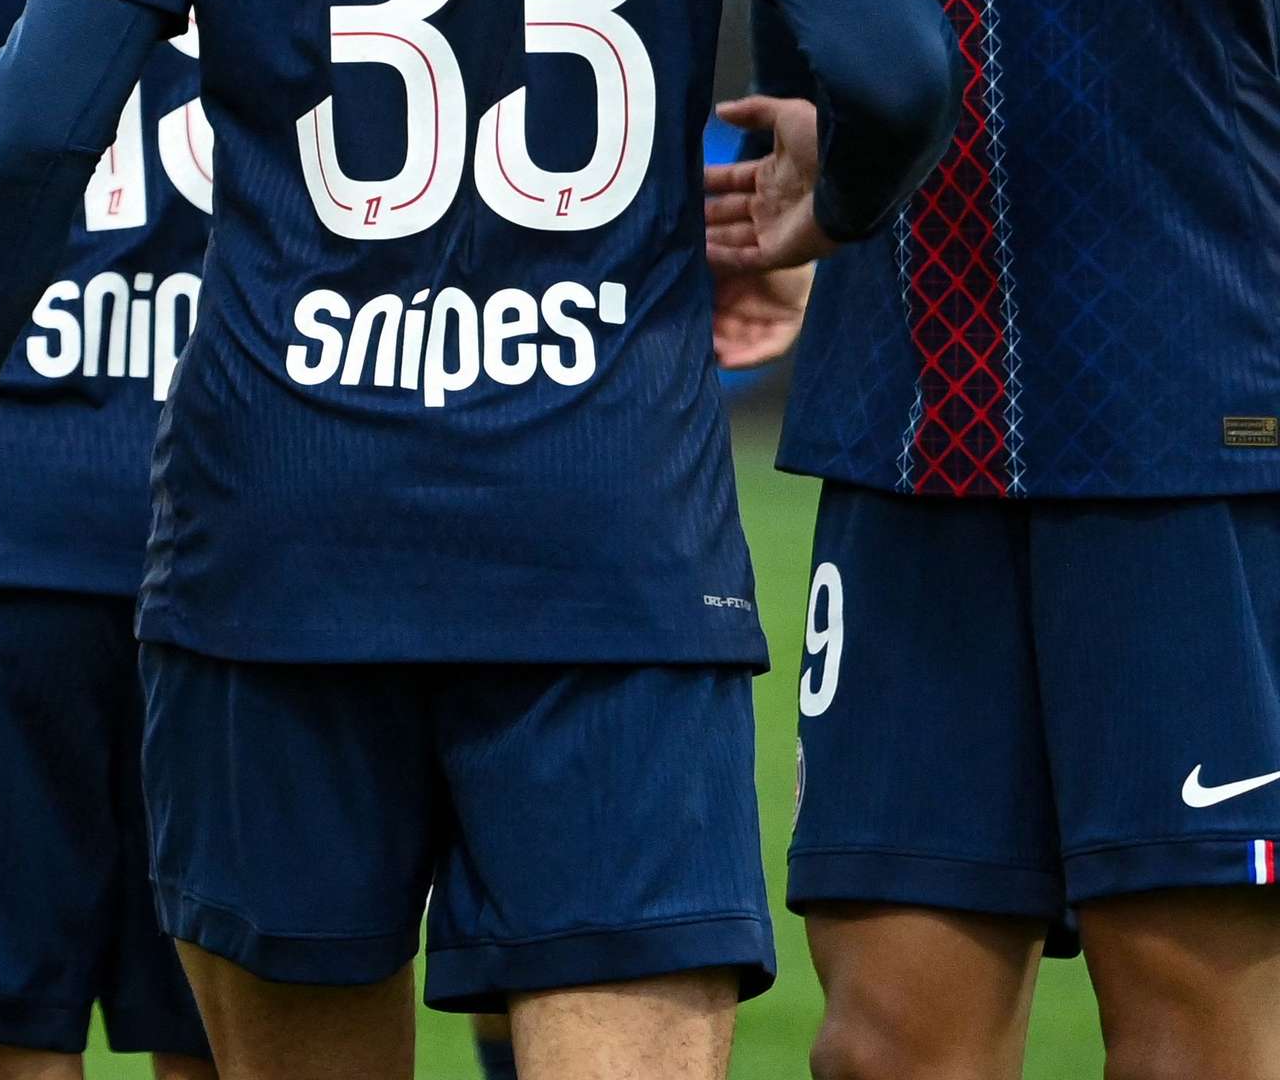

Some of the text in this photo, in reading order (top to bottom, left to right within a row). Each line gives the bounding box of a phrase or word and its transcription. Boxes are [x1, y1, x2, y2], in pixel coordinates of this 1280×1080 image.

[26, 271, 203, 402] snip
[285, 281, 598, 408] snipes
[799, 562, 844, 718] 9
